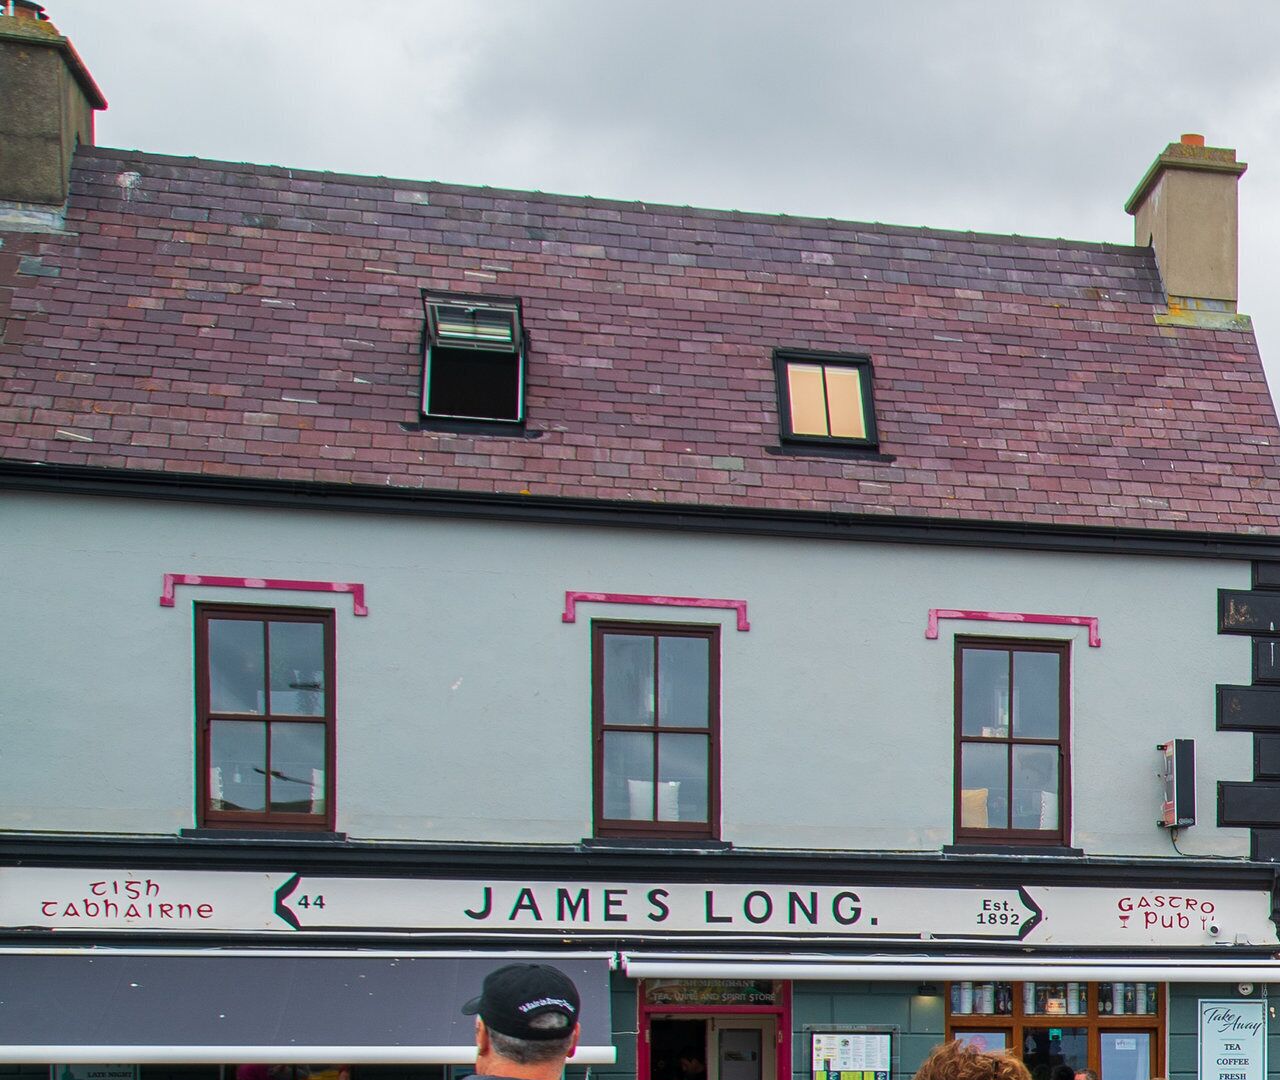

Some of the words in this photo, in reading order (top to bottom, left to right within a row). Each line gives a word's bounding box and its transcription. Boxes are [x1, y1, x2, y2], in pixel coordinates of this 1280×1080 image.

[297, 895, 326, 909] 44
[464, 886, 670, 923] JAMES
[705, 889, 879, 926] LONG.
[983, 899, 1014, 911] Est.
[976, 912, 1020, 925] 1892
[721, 993, 746, 1002] SPIRIT
[749, 993, 776, 1002] STORE
[1203, 1007, 1235, 1024] Take
[1218, 1015, 1263, 1036] Away
[1224, 1043, 1241, 1051] TEA
[1216, 1058, 1250, 1066] COFFEE
[1219, 1073, 1247, 1080] FRESH
